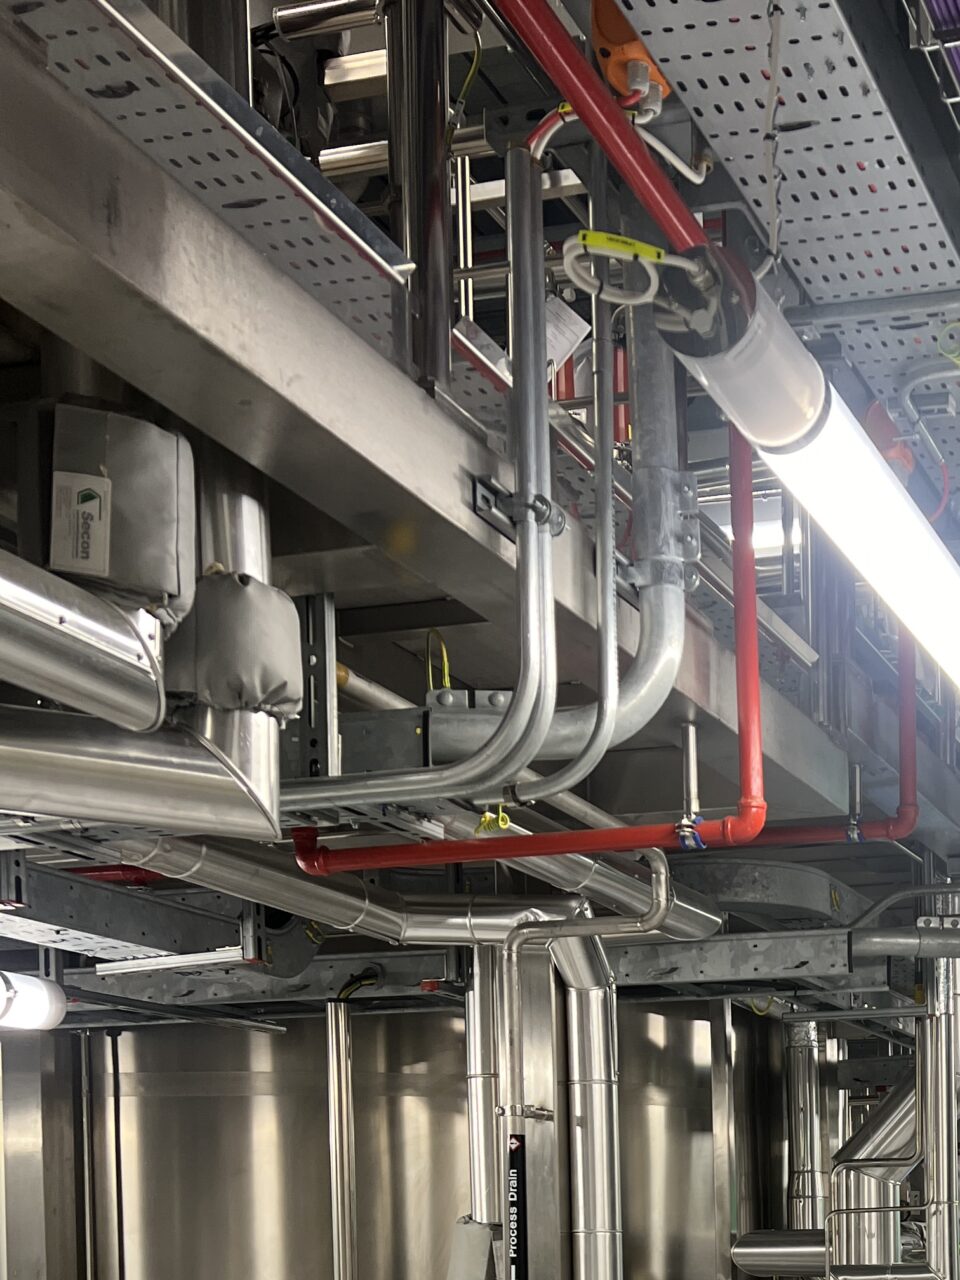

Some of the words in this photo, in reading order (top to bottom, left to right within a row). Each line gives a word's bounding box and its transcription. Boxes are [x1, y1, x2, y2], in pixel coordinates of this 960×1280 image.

[81, 511, 94, 559] Secon
[508, 1169, 518, 1201] Drain
[509, 1206, 518, 1257] Process
